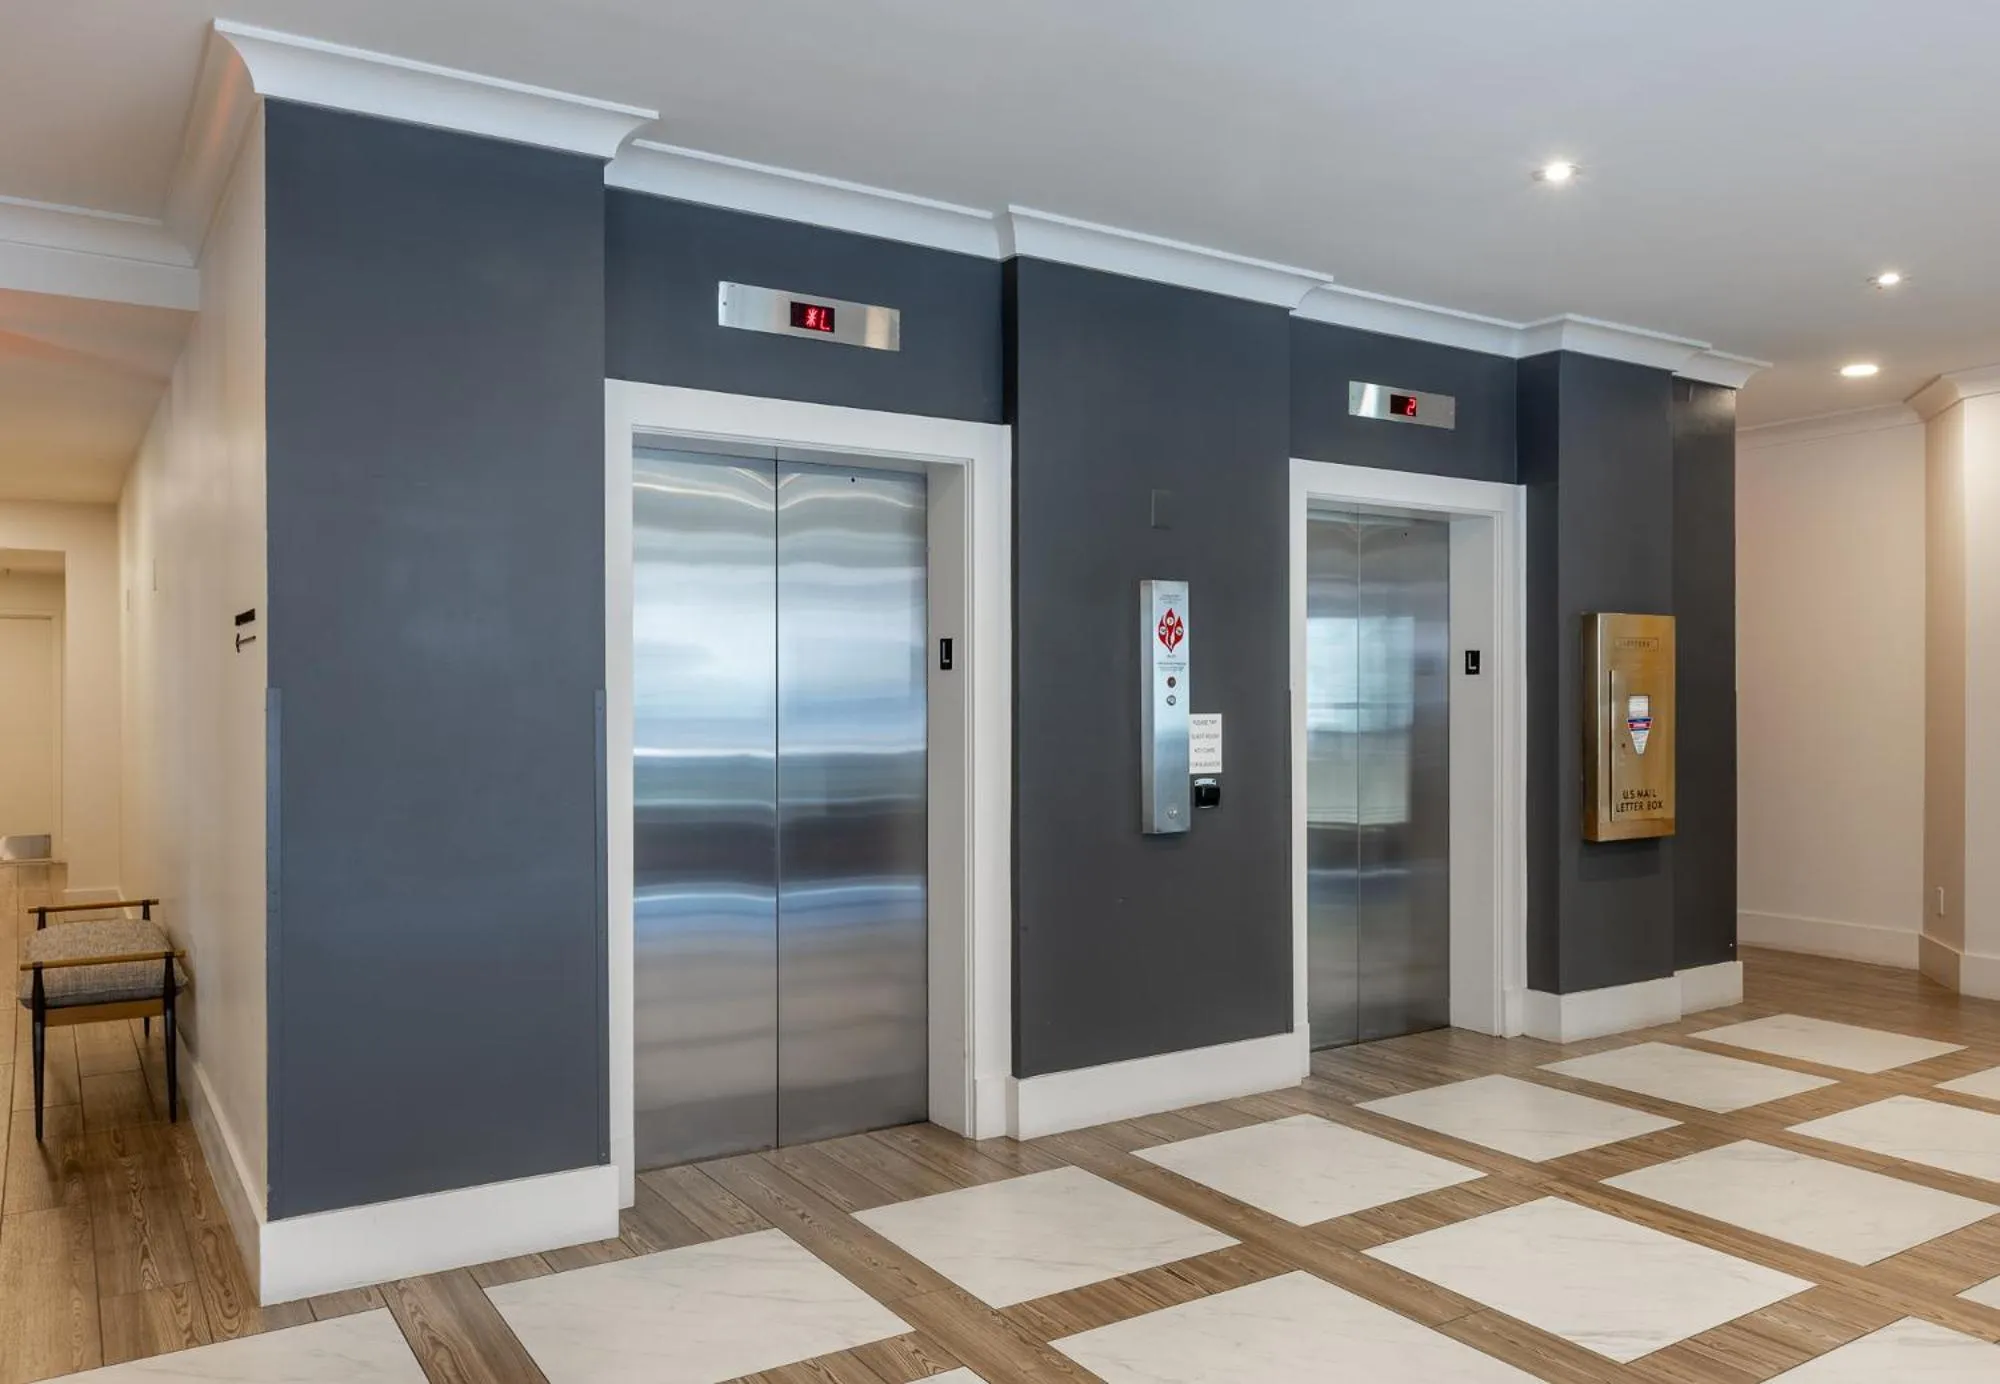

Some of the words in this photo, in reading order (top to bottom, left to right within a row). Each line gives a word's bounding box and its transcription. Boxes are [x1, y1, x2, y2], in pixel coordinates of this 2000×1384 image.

[1406, 398, 1417, 416] 2
[942, 641, 951, 664] L
[1468, 652, 1477, 670] L
[1616, 801, 1644, 812] LETTER
[1646, 800, 1664, 811] BOX
